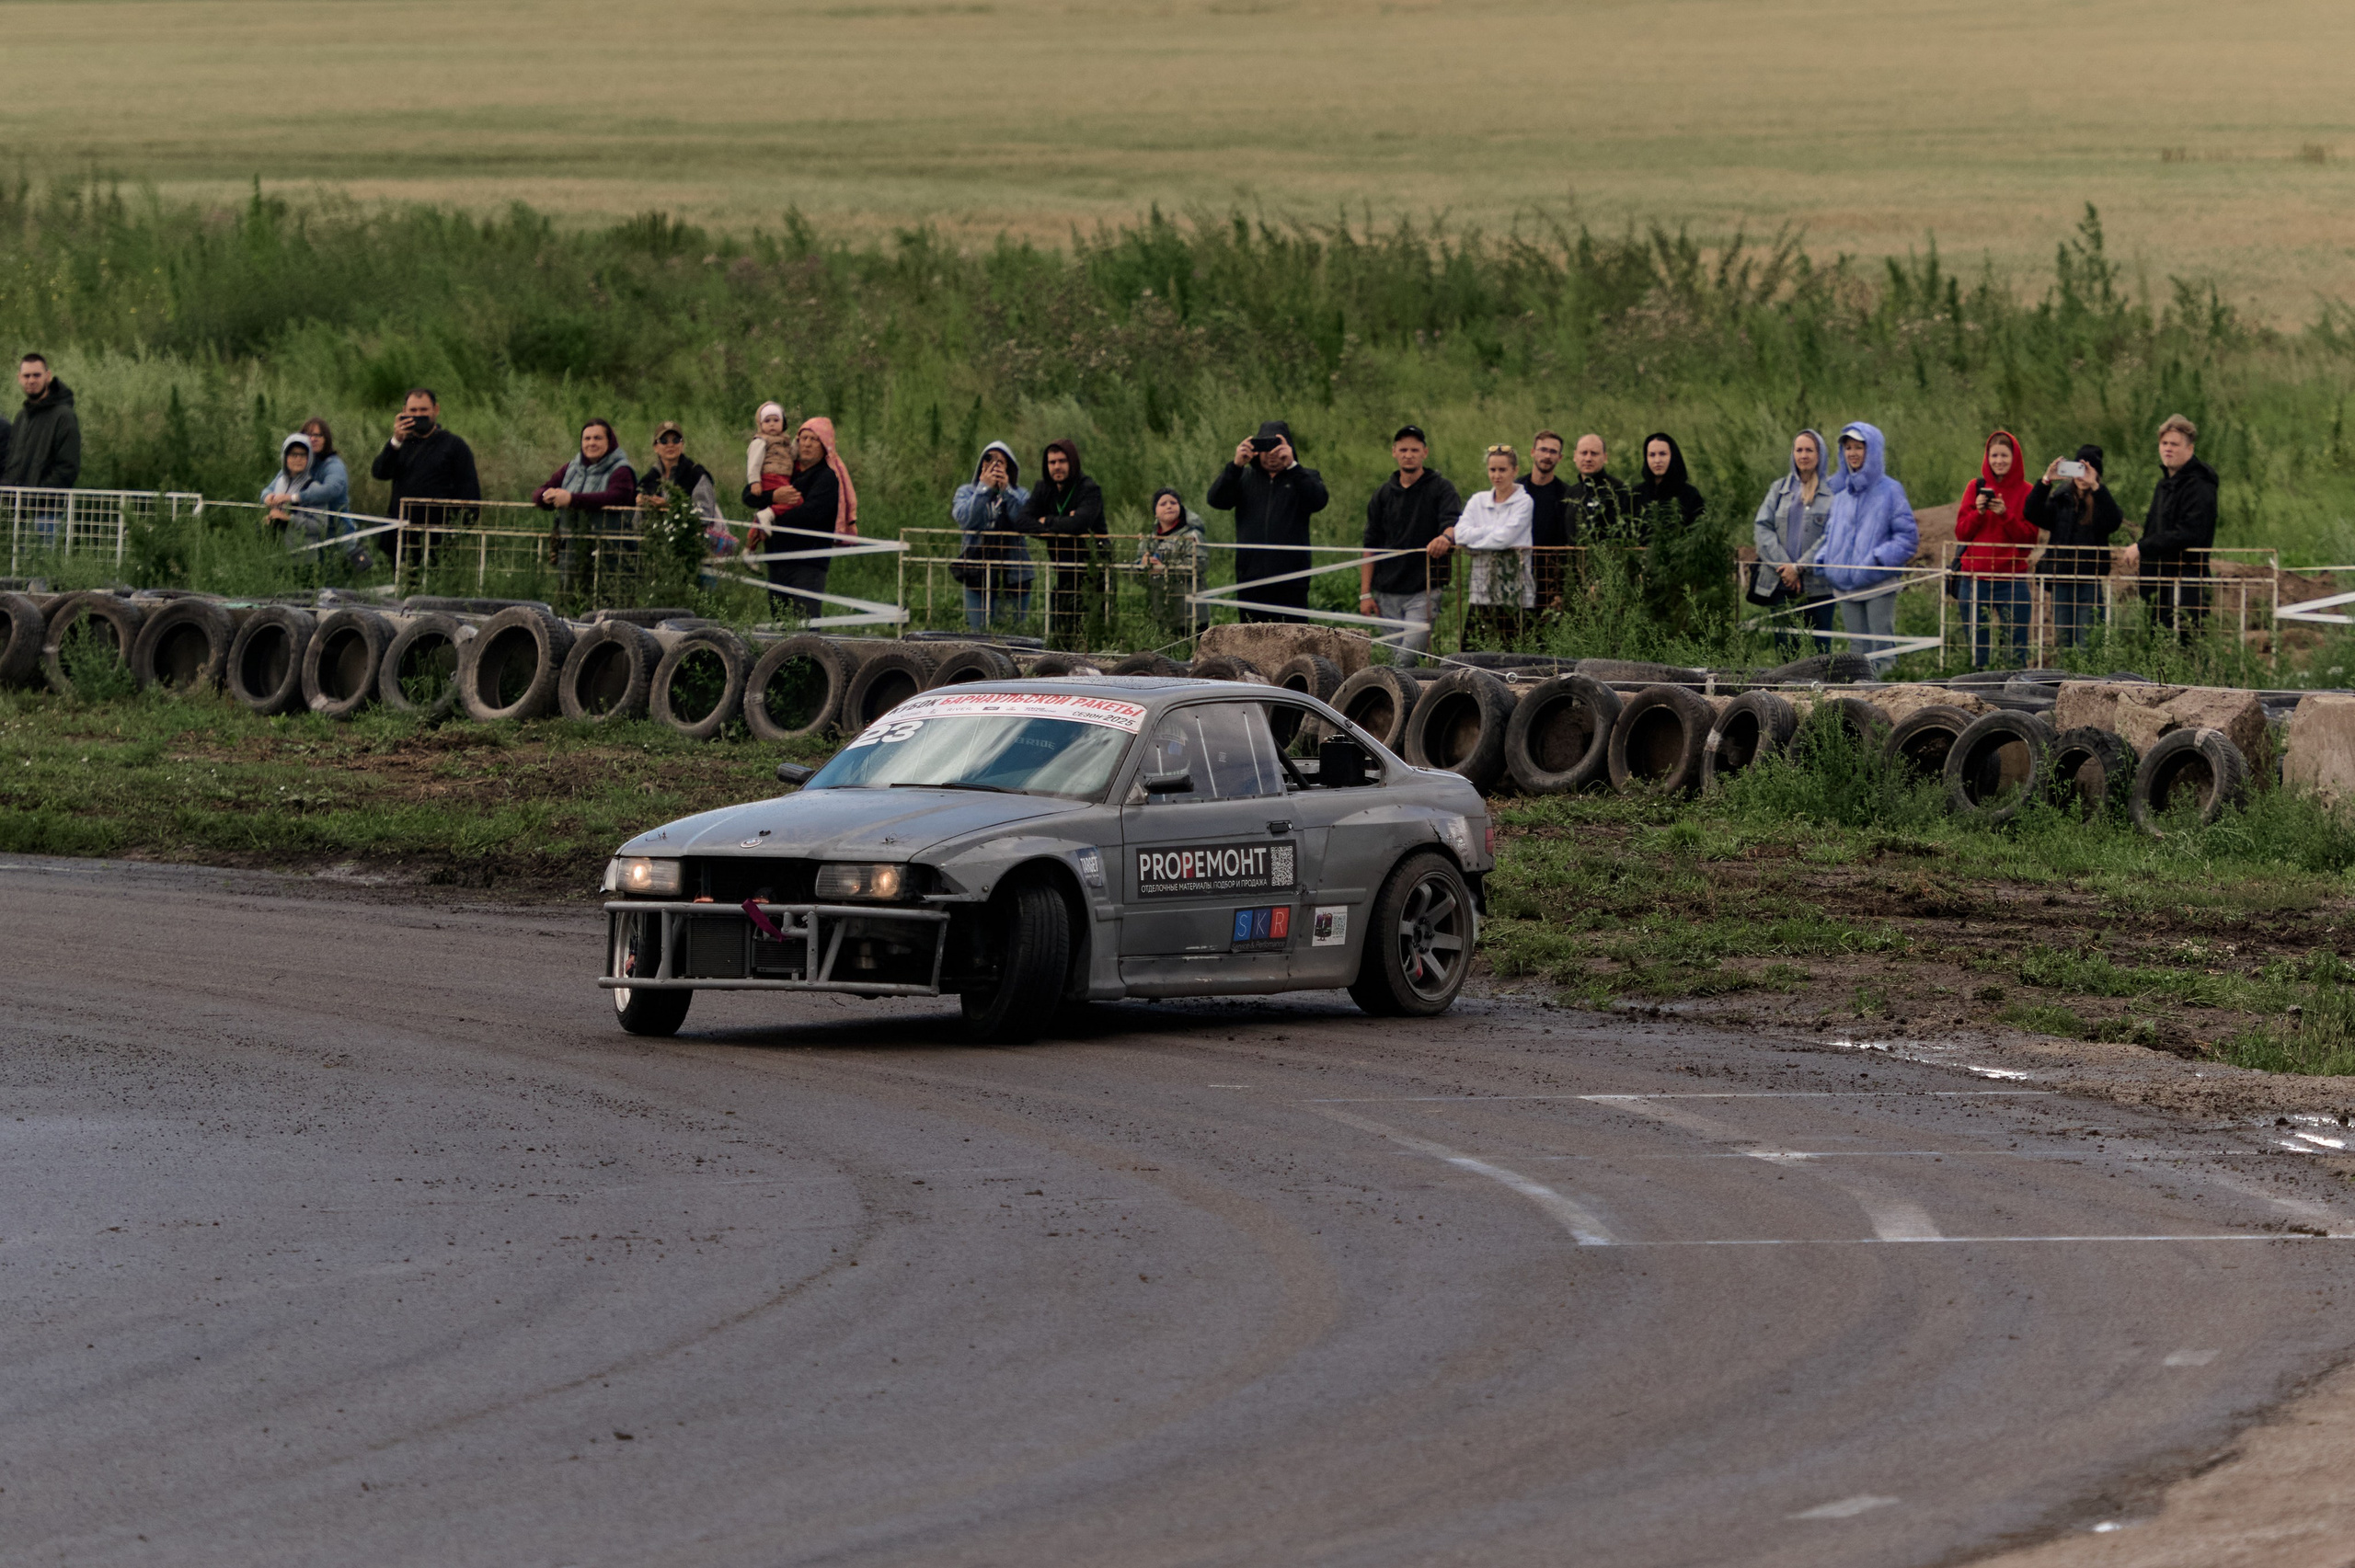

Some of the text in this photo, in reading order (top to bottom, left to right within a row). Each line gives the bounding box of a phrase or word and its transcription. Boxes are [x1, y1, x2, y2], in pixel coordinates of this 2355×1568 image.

[1070, 696, 1143, 717] РАКЕТЫ
[1073, 711, 1137, 726] СЕЗОН 2025
[845, 720, 925, 750] 23
[1141, 883, 1178, 894] ОТДЕЛОЧНЫЕ
[1212, 880, 1235, 890] ПОДБОР
[1235, 880, 1241, 888] И
[1241, 878, 1268, 888] ПРОДАЖА
